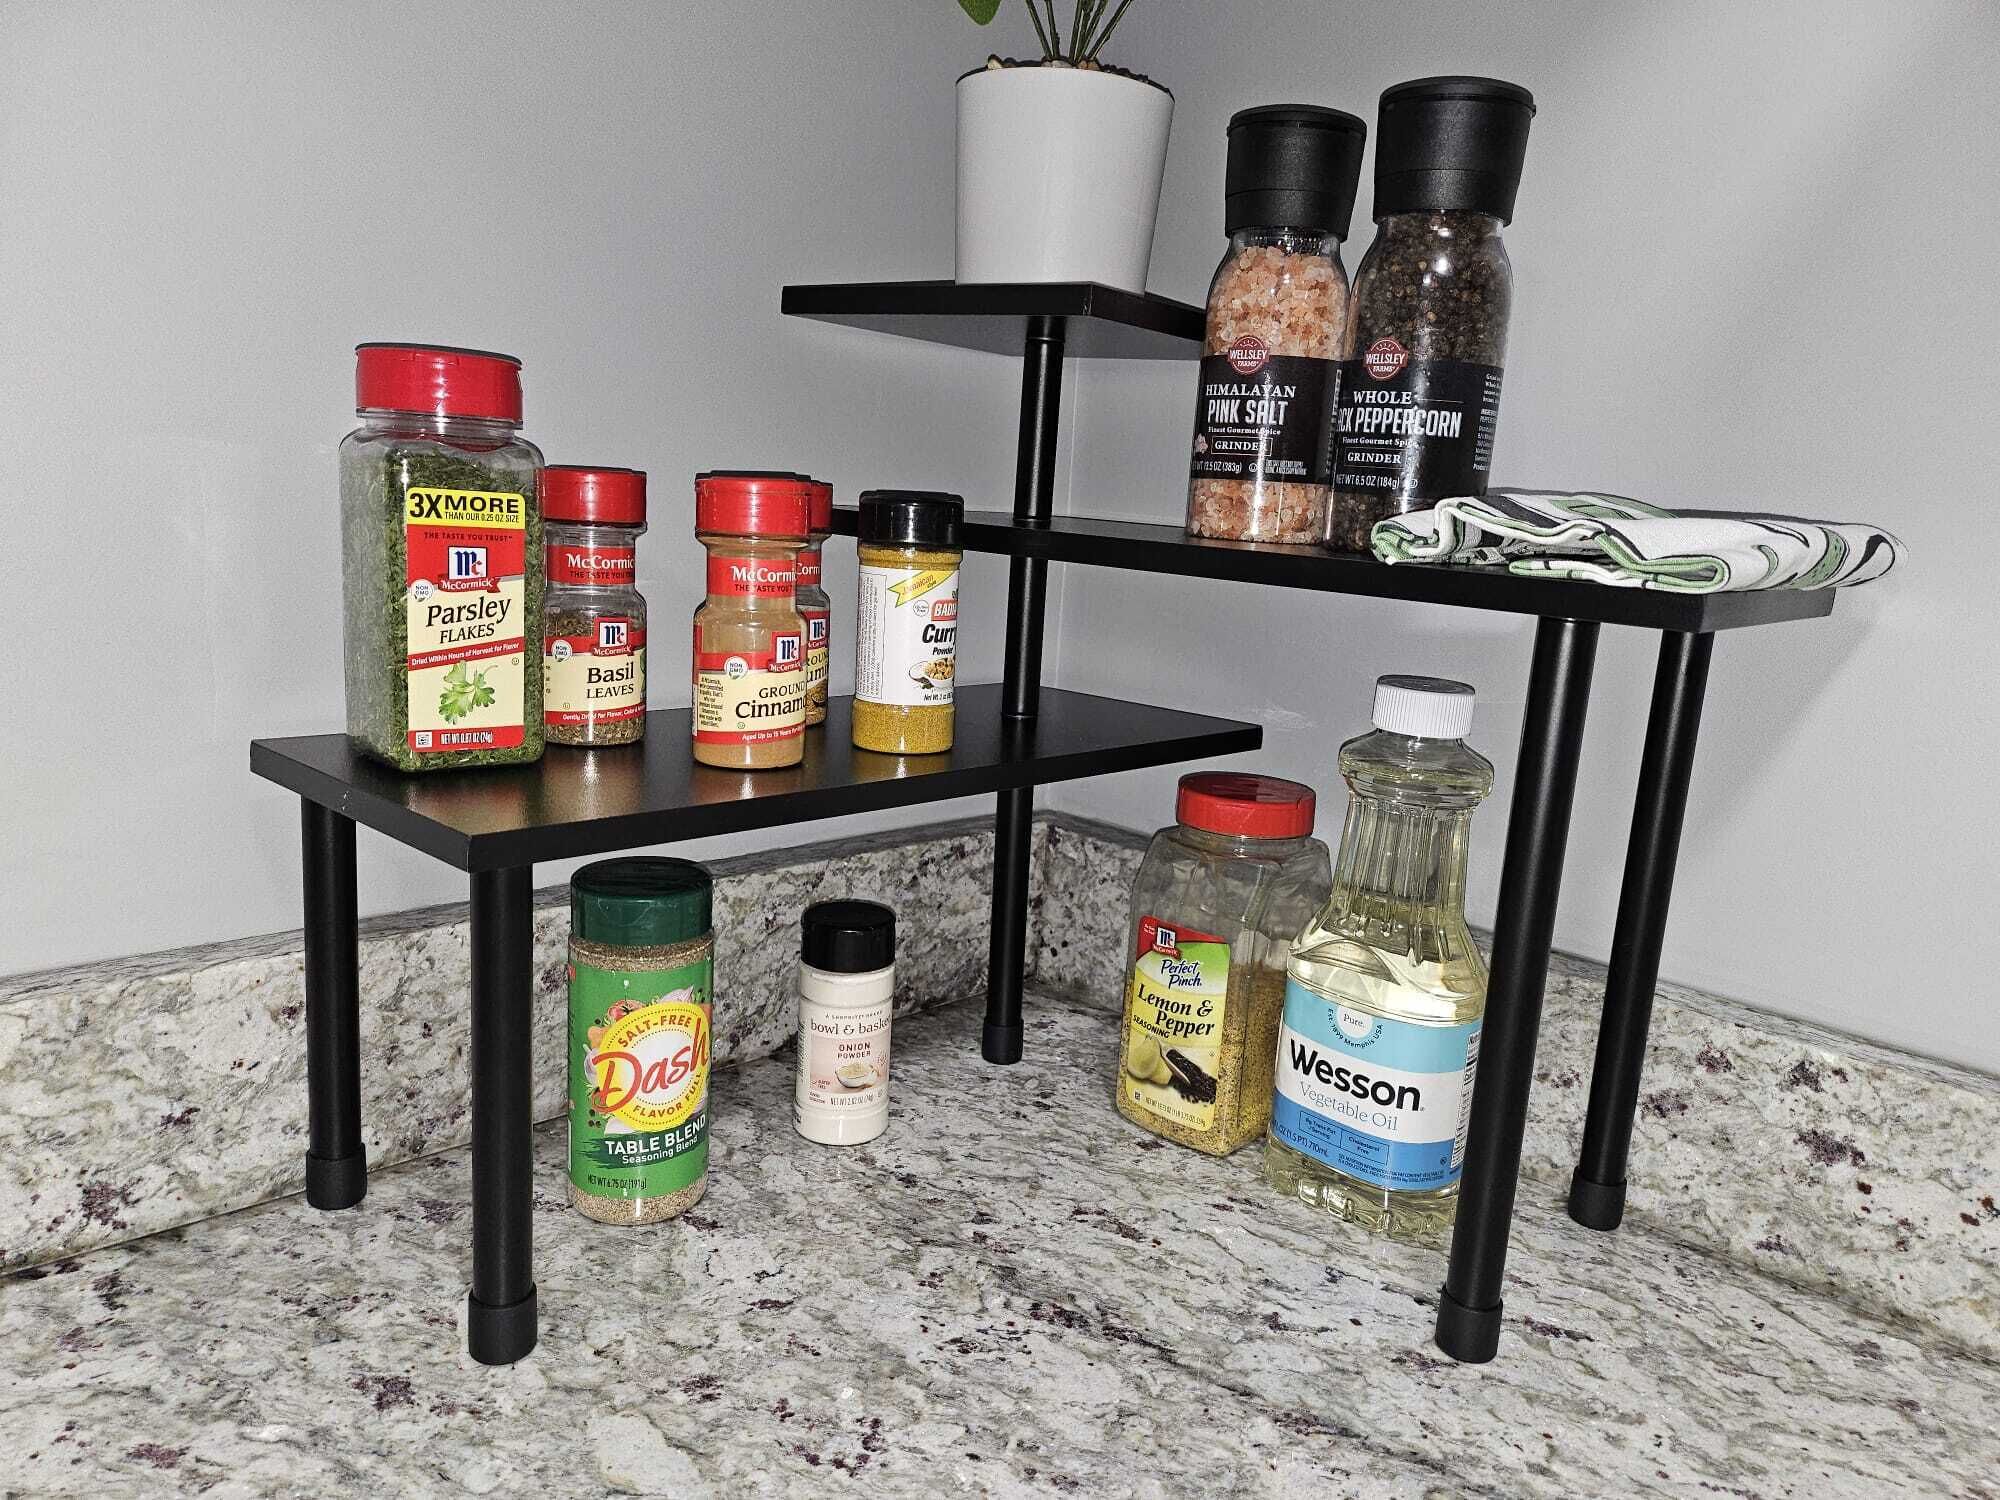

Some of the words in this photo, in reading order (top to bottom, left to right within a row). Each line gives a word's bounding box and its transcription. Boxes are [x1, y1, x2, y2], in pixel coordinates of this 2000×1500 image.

[1229, 349, 1268, 360] WELLSLEY
[1365, 353, 1405, 364] WELLSLEY
[1206, 384, 1296, 398] HIMALAYAN
[1353, 390, 1412, 404] WHOLE
[1208, 400, 1240, 424] PINK
[1245, 400, 1288, 425] SALT
[1355, 408, 1462, 438] PEPPERCORN
[1260, 427, 1281, 436] Spice
[1214, 440, 1267, 451] GRINDER
[1360, 437, 1393, 445] Gourmet
[1347, 452, 1401, 464] GRINDER
[1214, 462, 1221, 472] OZ
[1222, 462, 1242, 474] (383g)
[1345, 474, 1355, 485] WT
[1356, 475, 1365, 486] 6.5
[1366, 476, 1376, 487] OZ
[1377, 476, 1400, 490] (184g)
[409, 493, 442, 519] 3X
[445, 495, 518, 513] MORE
[445, 512, 464, 520] THAN
[466, 512, 480, 521] OUR
[481, 514, 494, 522] 0.25
[506, 515, 519, 523] SIZE
[566, 553, 634, 569] McCormic
[441, 579, 492, 590] McCormick
[735, 584, 749, 592] THE
[426, 596, 512, 627] Parsley
[440, 622, 495, 644] FLAKES
[412, 657, 428, 666] Dried
[428, 654, 448, 663] Within
[448, 650, 465, 659] Hours
[472, 646, 493, 656] Harvest
[494, 644, 503, 653] for
[503, 643, 520, 652] Flavor
[594, 646, 631, 655] McCormick
[587, 661, 634, 684] Basil
[770, 660, 800, 671] McCormick
[586, 684, 634, 699] LEAVES
[759, 680, 805, 699] GROUND
[581, 712, 597, 720] Dried
[441, 734, 451, 745] NET
[452, 733, 460, 744] WT
[473, 732, 480, 743] OZ
[1161, 960, 1199, 974] Perfect
[1138, 984, 1193, 1015] Lemon
[1196, 1000, 1213, 1017] &
[618, 1014, 692, 1048] SALT-FREE
[811, 1018, 838, 1035] bowl
[844, 1024, 854, 1035] &
[1133, 1015, 1170, 1038] SEASONING
[1156, 1010, 1215, 1038] Pepper
[1331, 1024, 1344, 1039] 1899
[1344, 1038, 1375, 1048] Memphis
[1372, 1024, 1383, 1039] USA
[838, 1050, 871, 1059] POWDER
[839, 1042, 870, 1052] ONION
[592, 1018, 709, 1114] Dash
[1290, 1038, 1421, 1111] Wesson
[633, 1102, 683, 1118] FLAVOR
[685, 1072, 702, 1101] FULL
[1300, 1082, 1370, 1122] Vegetable
[1372, 1112, 1398, 1131] Oil
[604, 1136, 660, 1155] TABLE
[664, 1114, 706, 1148] BLEND
[622, 1149, 674, 1164] Seasoning
[676, 1135, 698, 1153] Blend
[1349, 1136, 1380, 1152] Cholesterol
[588, 1174, 597, 1185] NET
[598, 1177, 607, 1188] WT
[620, 1180, 628, 1189] OZ
